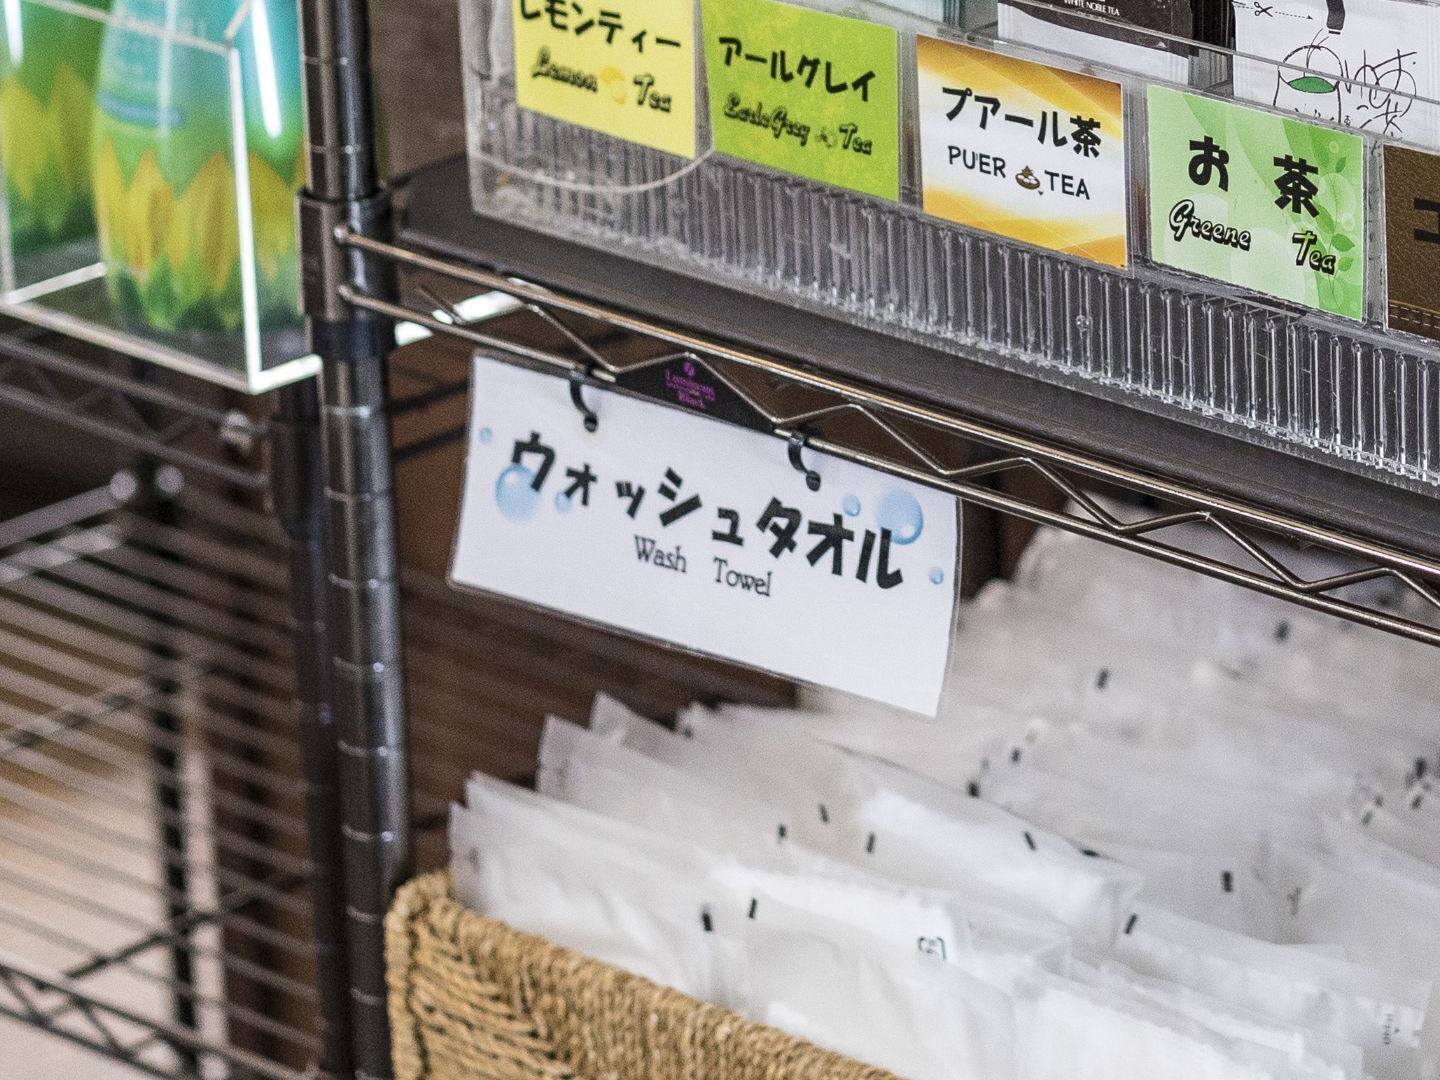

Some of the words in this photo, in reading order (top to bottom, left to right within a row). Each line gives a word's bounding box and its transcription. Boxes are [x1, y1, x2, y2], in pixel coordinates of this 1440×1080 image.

[1086, 1, 1107, 14] NOBLE
[1107, 6, 1121, 16] TEA
[633, 73, 672, 113] Tea
[719, 37, 875, 102] アールグレイ
[839, 122, 873, 155] Tea
[941, 85, 1102, 158] プアール茶
[1045, 171, 1090, 200] TEA
[1168, 199, 1251, 253] Greene
[1293, 229, 1336, 276] Tea
[511, 431, 903, 589] ウォッシュタオル
[633, 535, 687, 574] Wash
[714, 557, 772, 597] Towel
